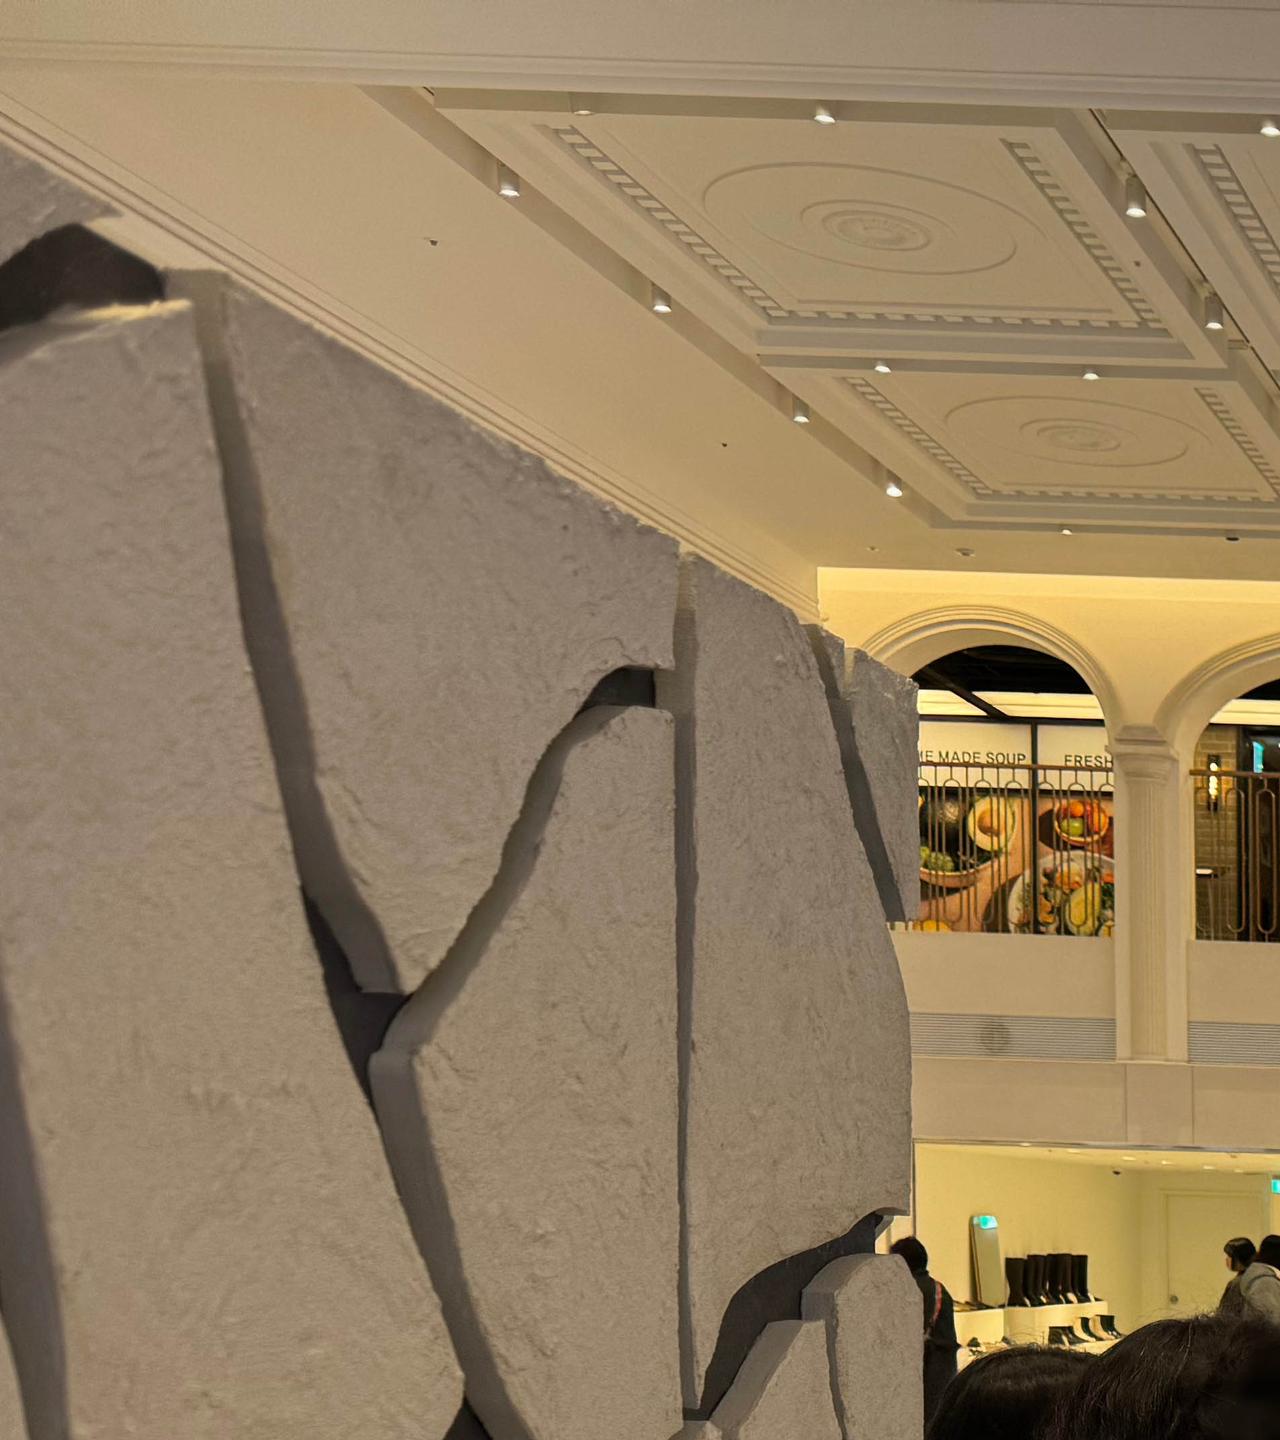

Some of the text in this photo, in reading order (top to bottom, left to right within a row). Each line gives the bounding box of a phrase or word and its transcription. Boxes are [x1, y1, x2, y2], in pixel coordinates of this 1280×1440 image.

[938, 750, 982, 765] MADE
[986, 752, 1027, 766] SOUP
[1064, 754, 1114, 768] FRESH
